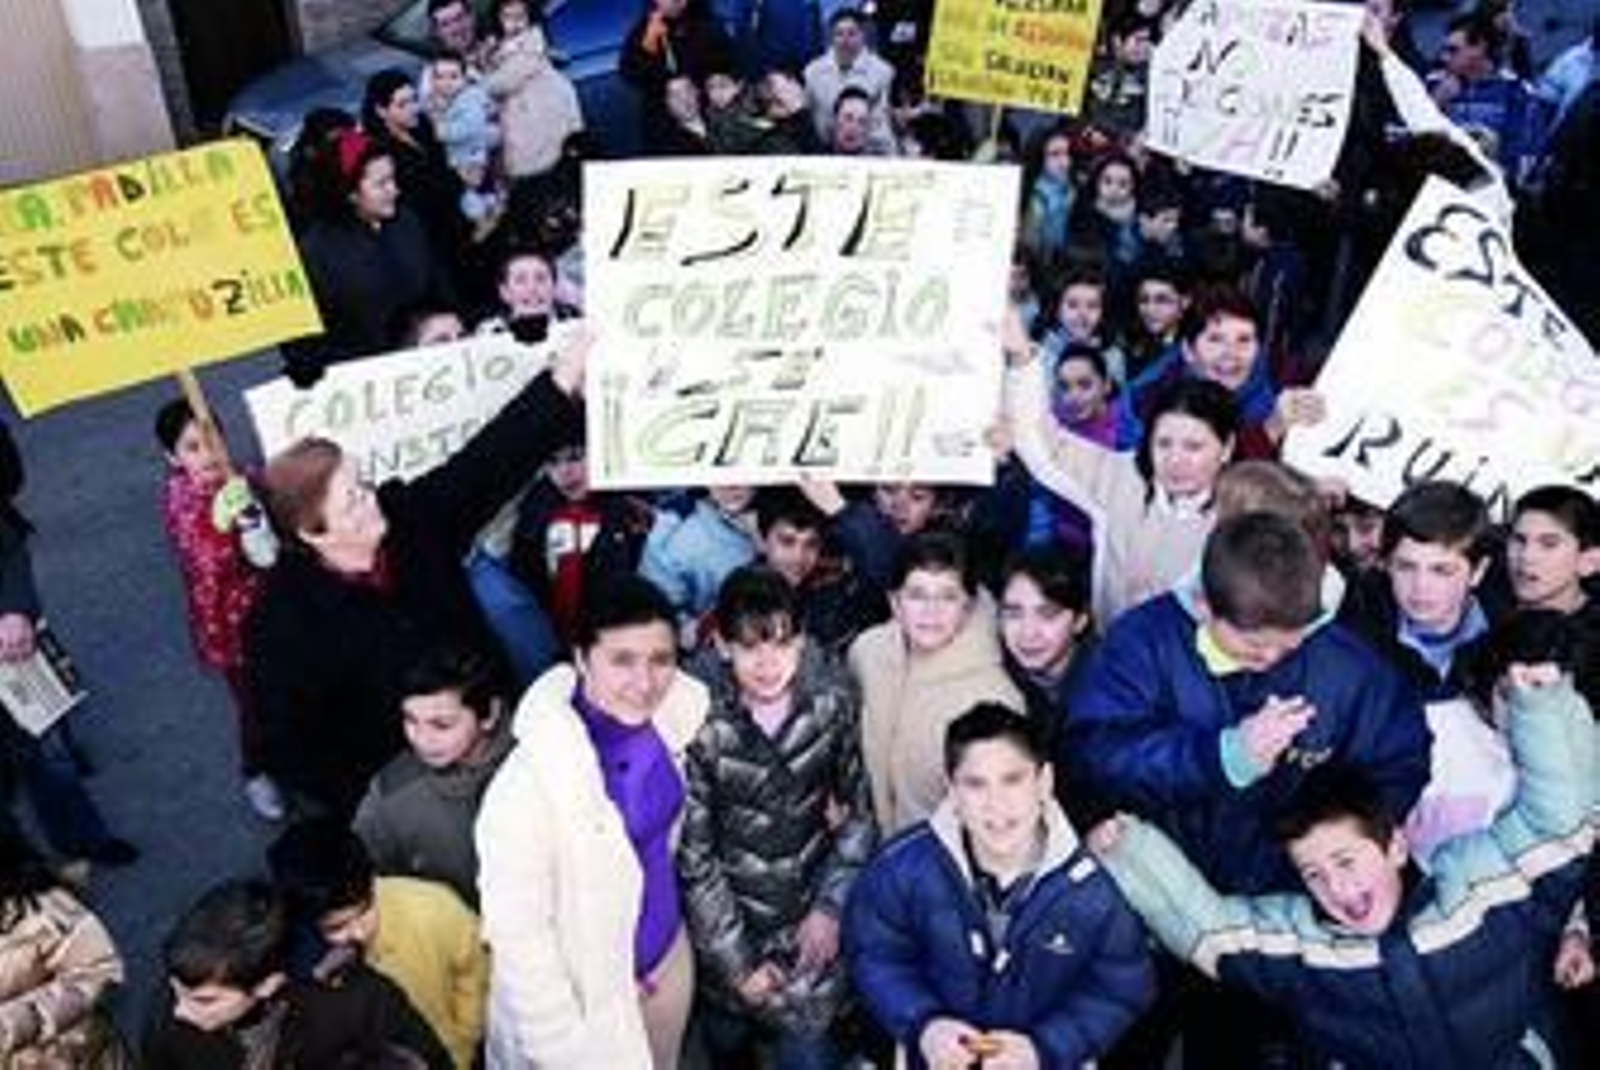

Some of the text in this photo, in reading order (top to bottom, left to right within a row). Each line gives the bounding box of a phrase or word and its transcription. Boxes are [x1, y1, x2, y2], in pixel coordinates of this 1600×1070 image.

[607, 172, 938, 267] ESTE
[623, 267, 952, 341] COLEGIO
[1404, 203, 1568, 351] ESTE
